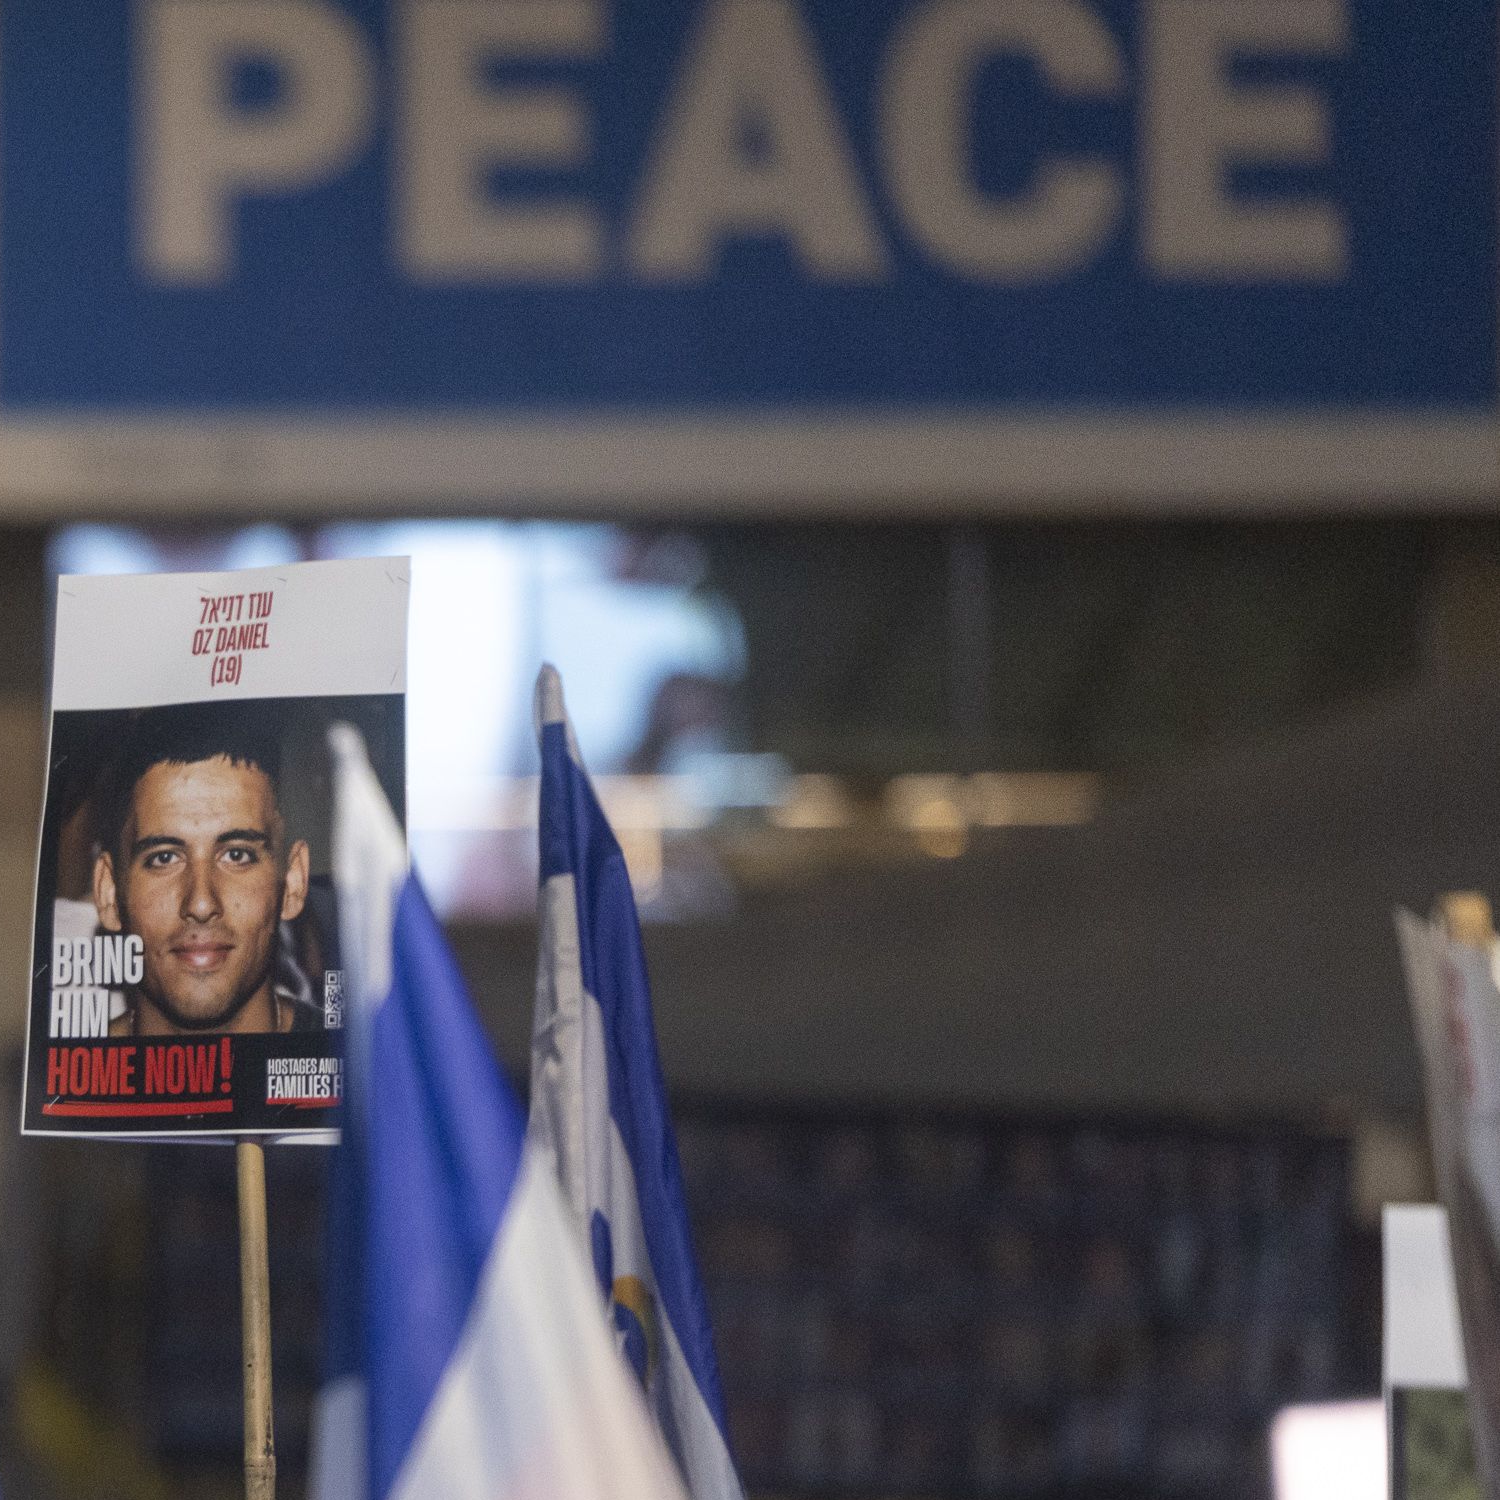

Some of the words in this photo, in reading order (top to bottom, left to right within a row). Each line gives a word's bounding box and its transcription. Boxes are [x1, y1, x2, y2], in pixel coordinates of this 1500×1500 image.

[135, 0, 1350, 285] PEACE
[200, 594, 244, 625] דניאל
[248, 591, 274, 619] עוז
[191, 629, 211, 656] OZ
[215, 623, 270, 654] DANIEL
[210, 655, 243, 688] (19)
[52, 934, 144, 986] BRING
[50, 989, 110, 1039] HIM
[46, 1046, 136, 1097] HOME
[144, 1037, 233, 1096] NOW!
[267, 1058, 317, 1075] HOSTAGES
[319, 1057, 338, 1074] AND
[267, 1075, 330, 1098] FAMILIES
